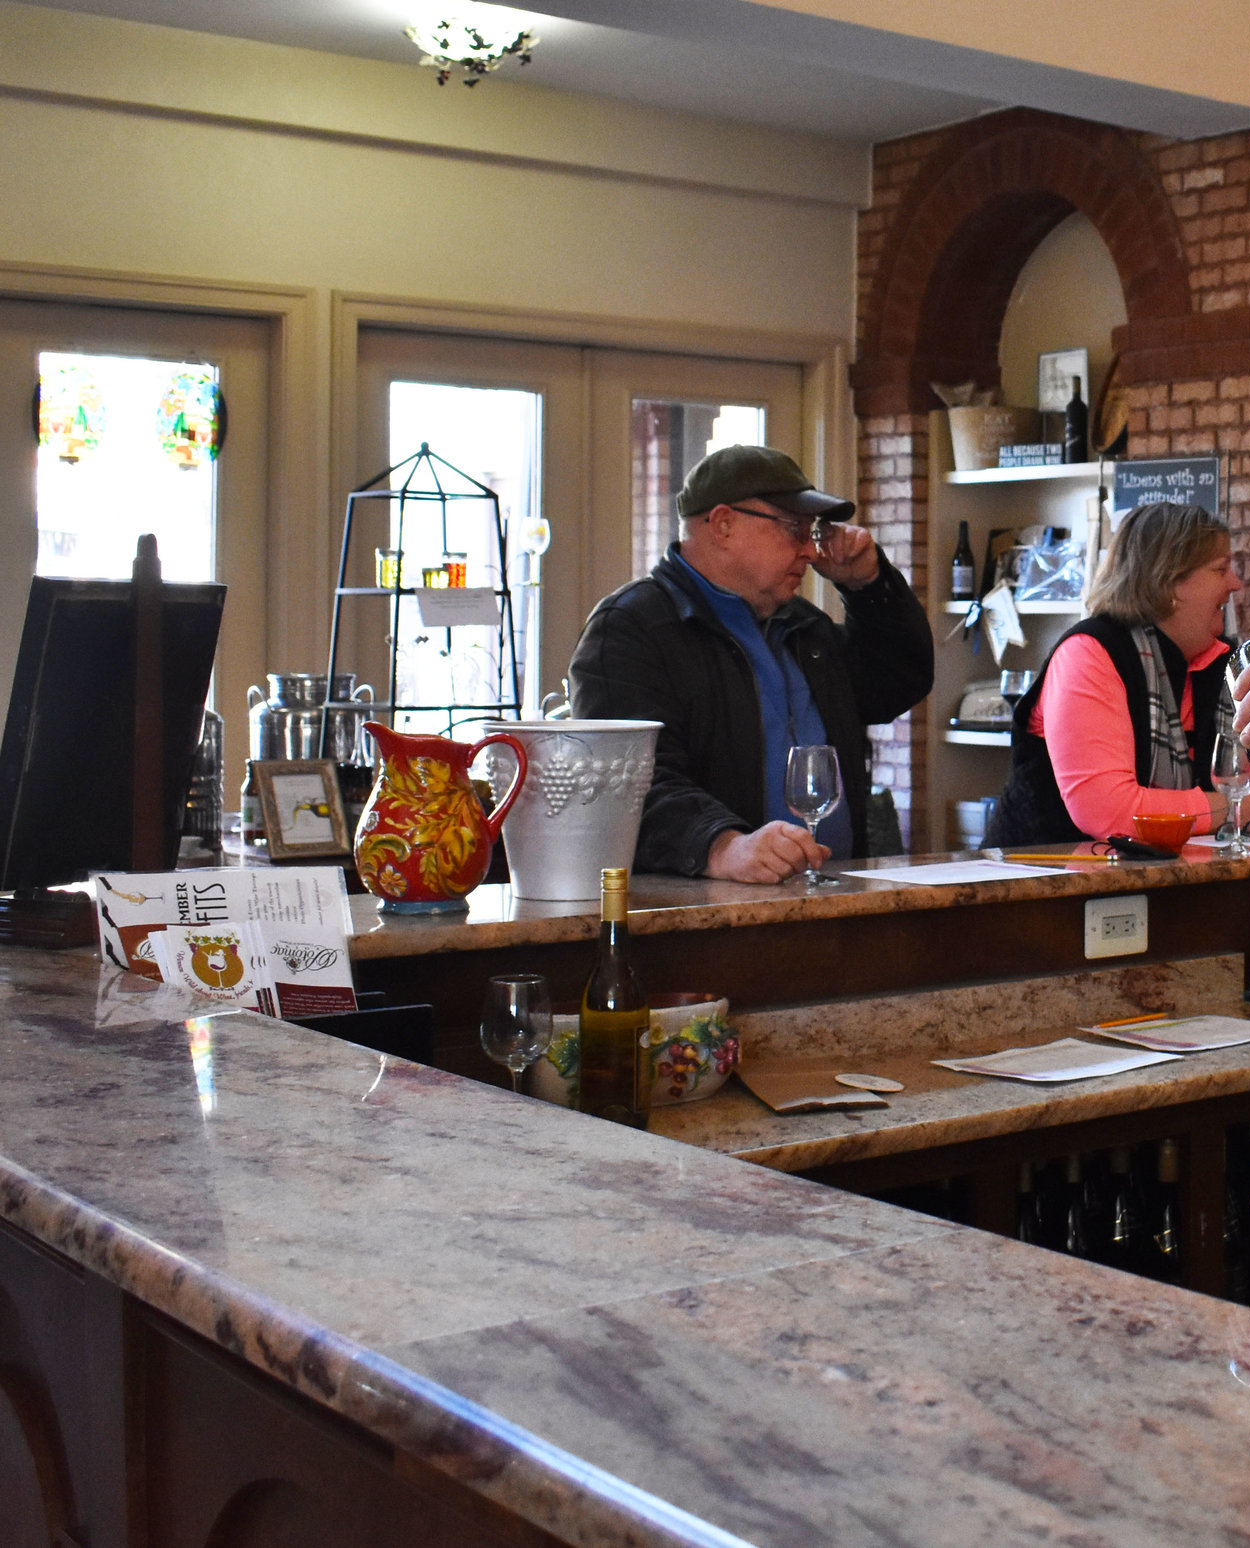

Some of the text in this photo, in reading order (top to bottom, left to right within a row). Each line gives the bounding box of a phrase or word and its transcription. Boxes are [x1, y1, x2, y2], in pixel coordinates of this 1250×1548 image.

[1166, 468, 1194, 486] with
[1198, 472, 1214, 485] an
[176, 882, 192, 924] MBER
[270, 943, 345, 972] Potomac
